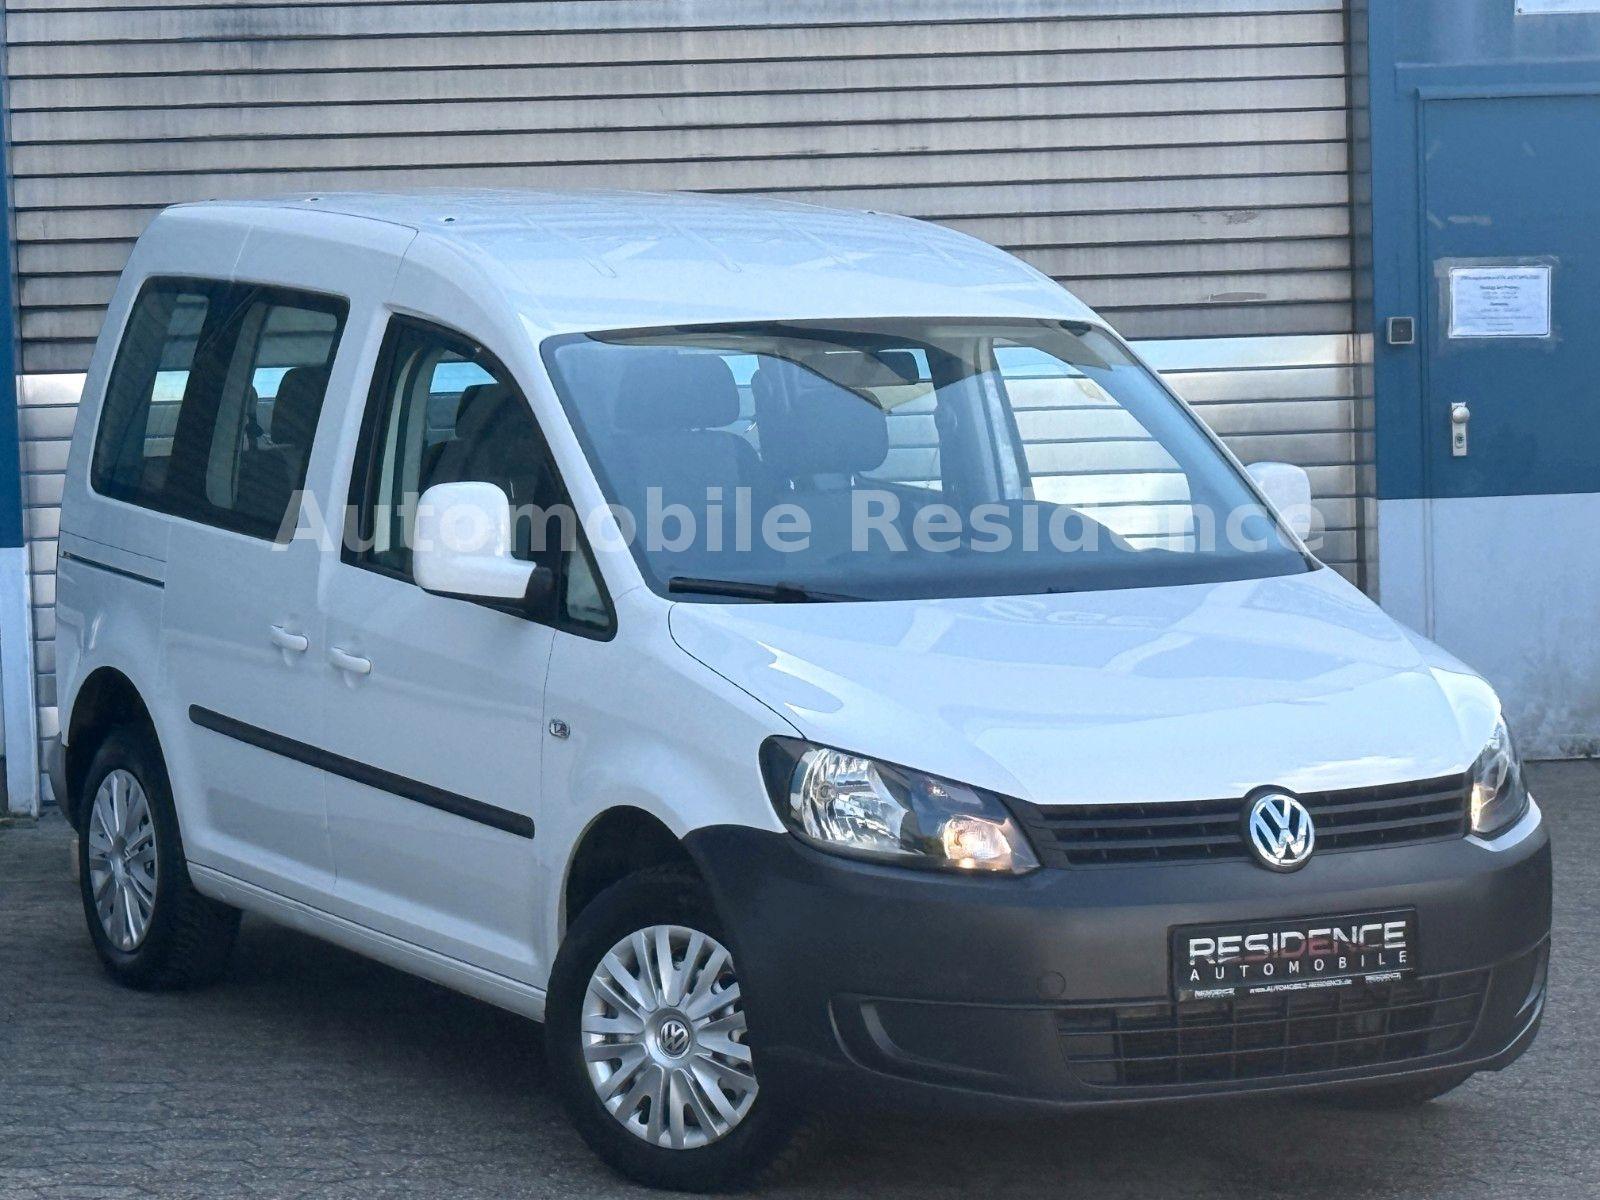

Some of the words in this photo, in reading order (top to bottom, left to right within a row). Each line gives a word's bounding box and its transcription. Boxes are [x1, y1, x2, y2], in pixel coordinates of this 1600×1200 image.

[1250, 794, 1315, 866] VW
[1189, 920, 1406, 966] RESIDENCE
[1189, 950, 1407, 982] AUTOMOBILE
